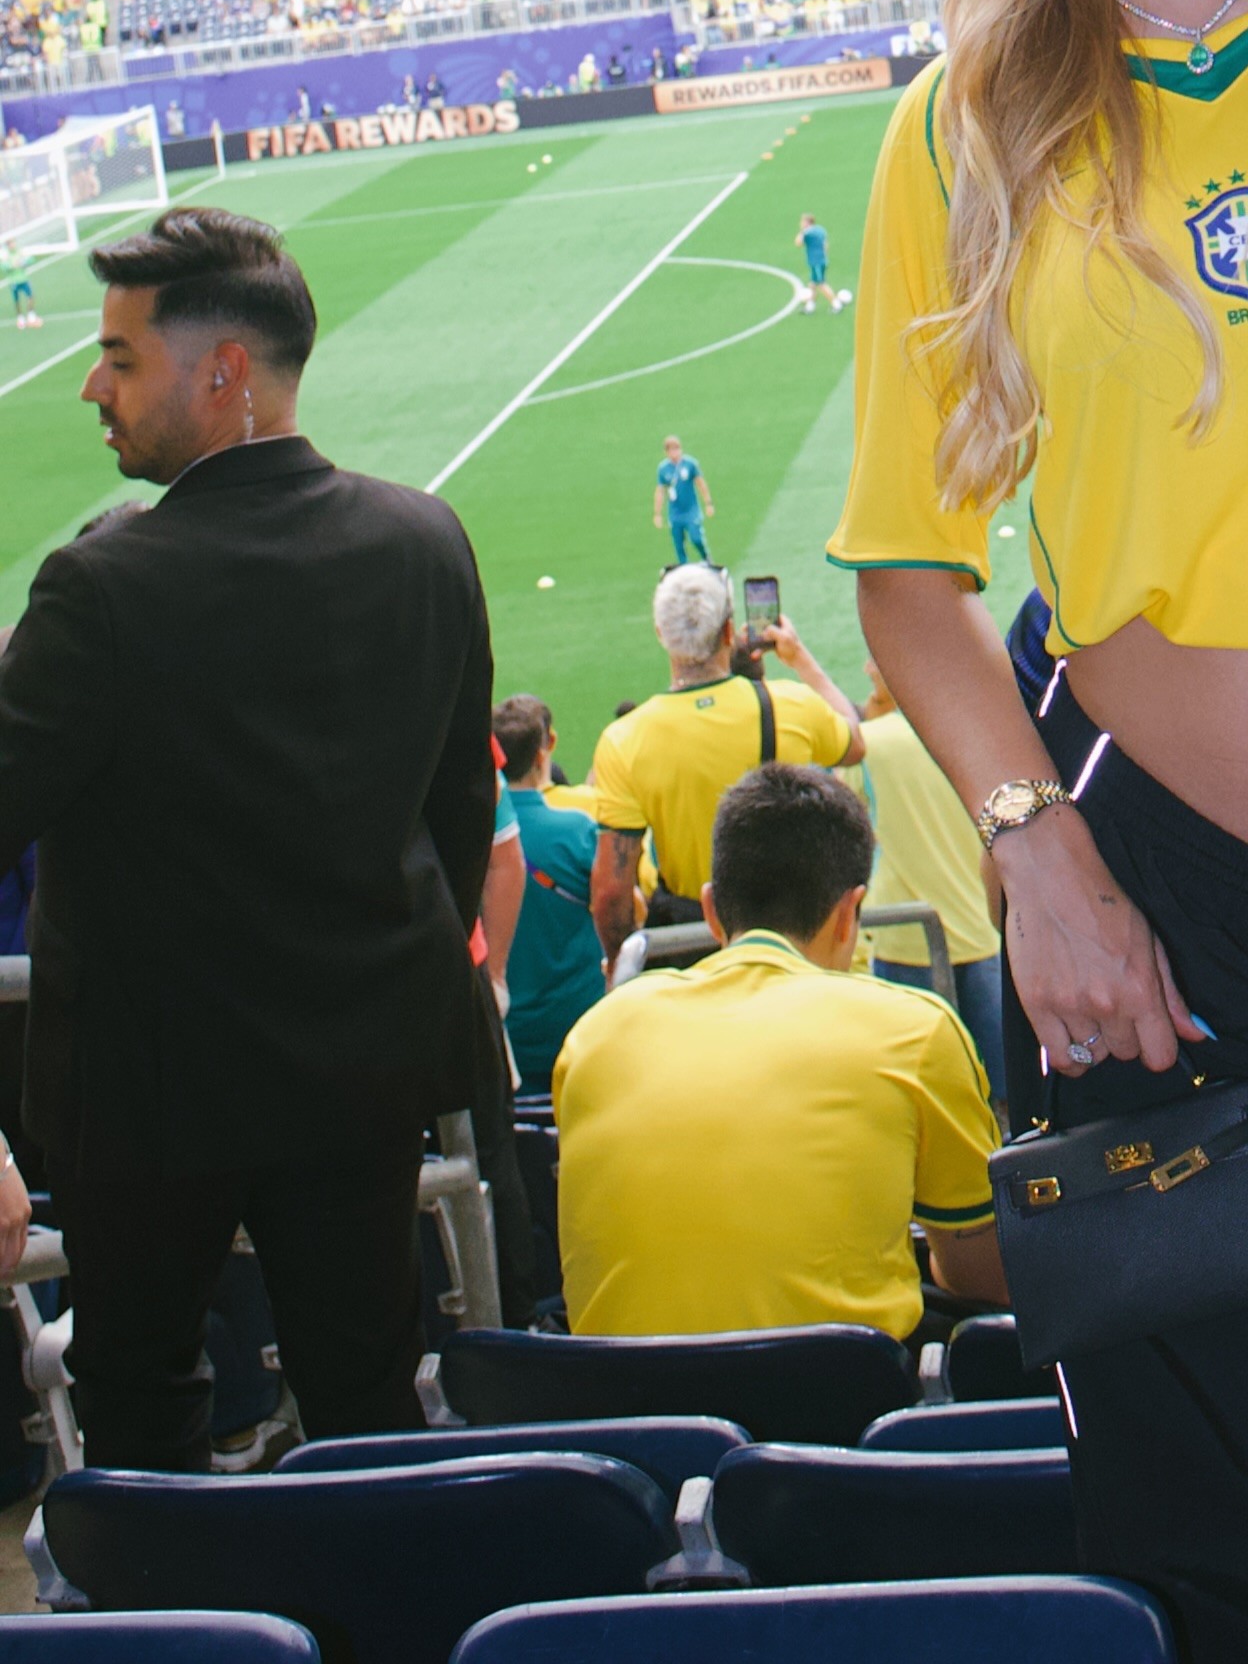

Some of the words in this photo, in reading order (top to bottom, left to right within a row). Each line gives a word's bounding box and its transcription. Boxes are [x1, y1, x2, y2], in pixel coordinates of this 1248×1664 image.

[673, 68, 873, 105] REWARDS.FIFA.COM
[247, 122, 331, 161] FIFA
[335, 100, 519, 149] REWARDS
